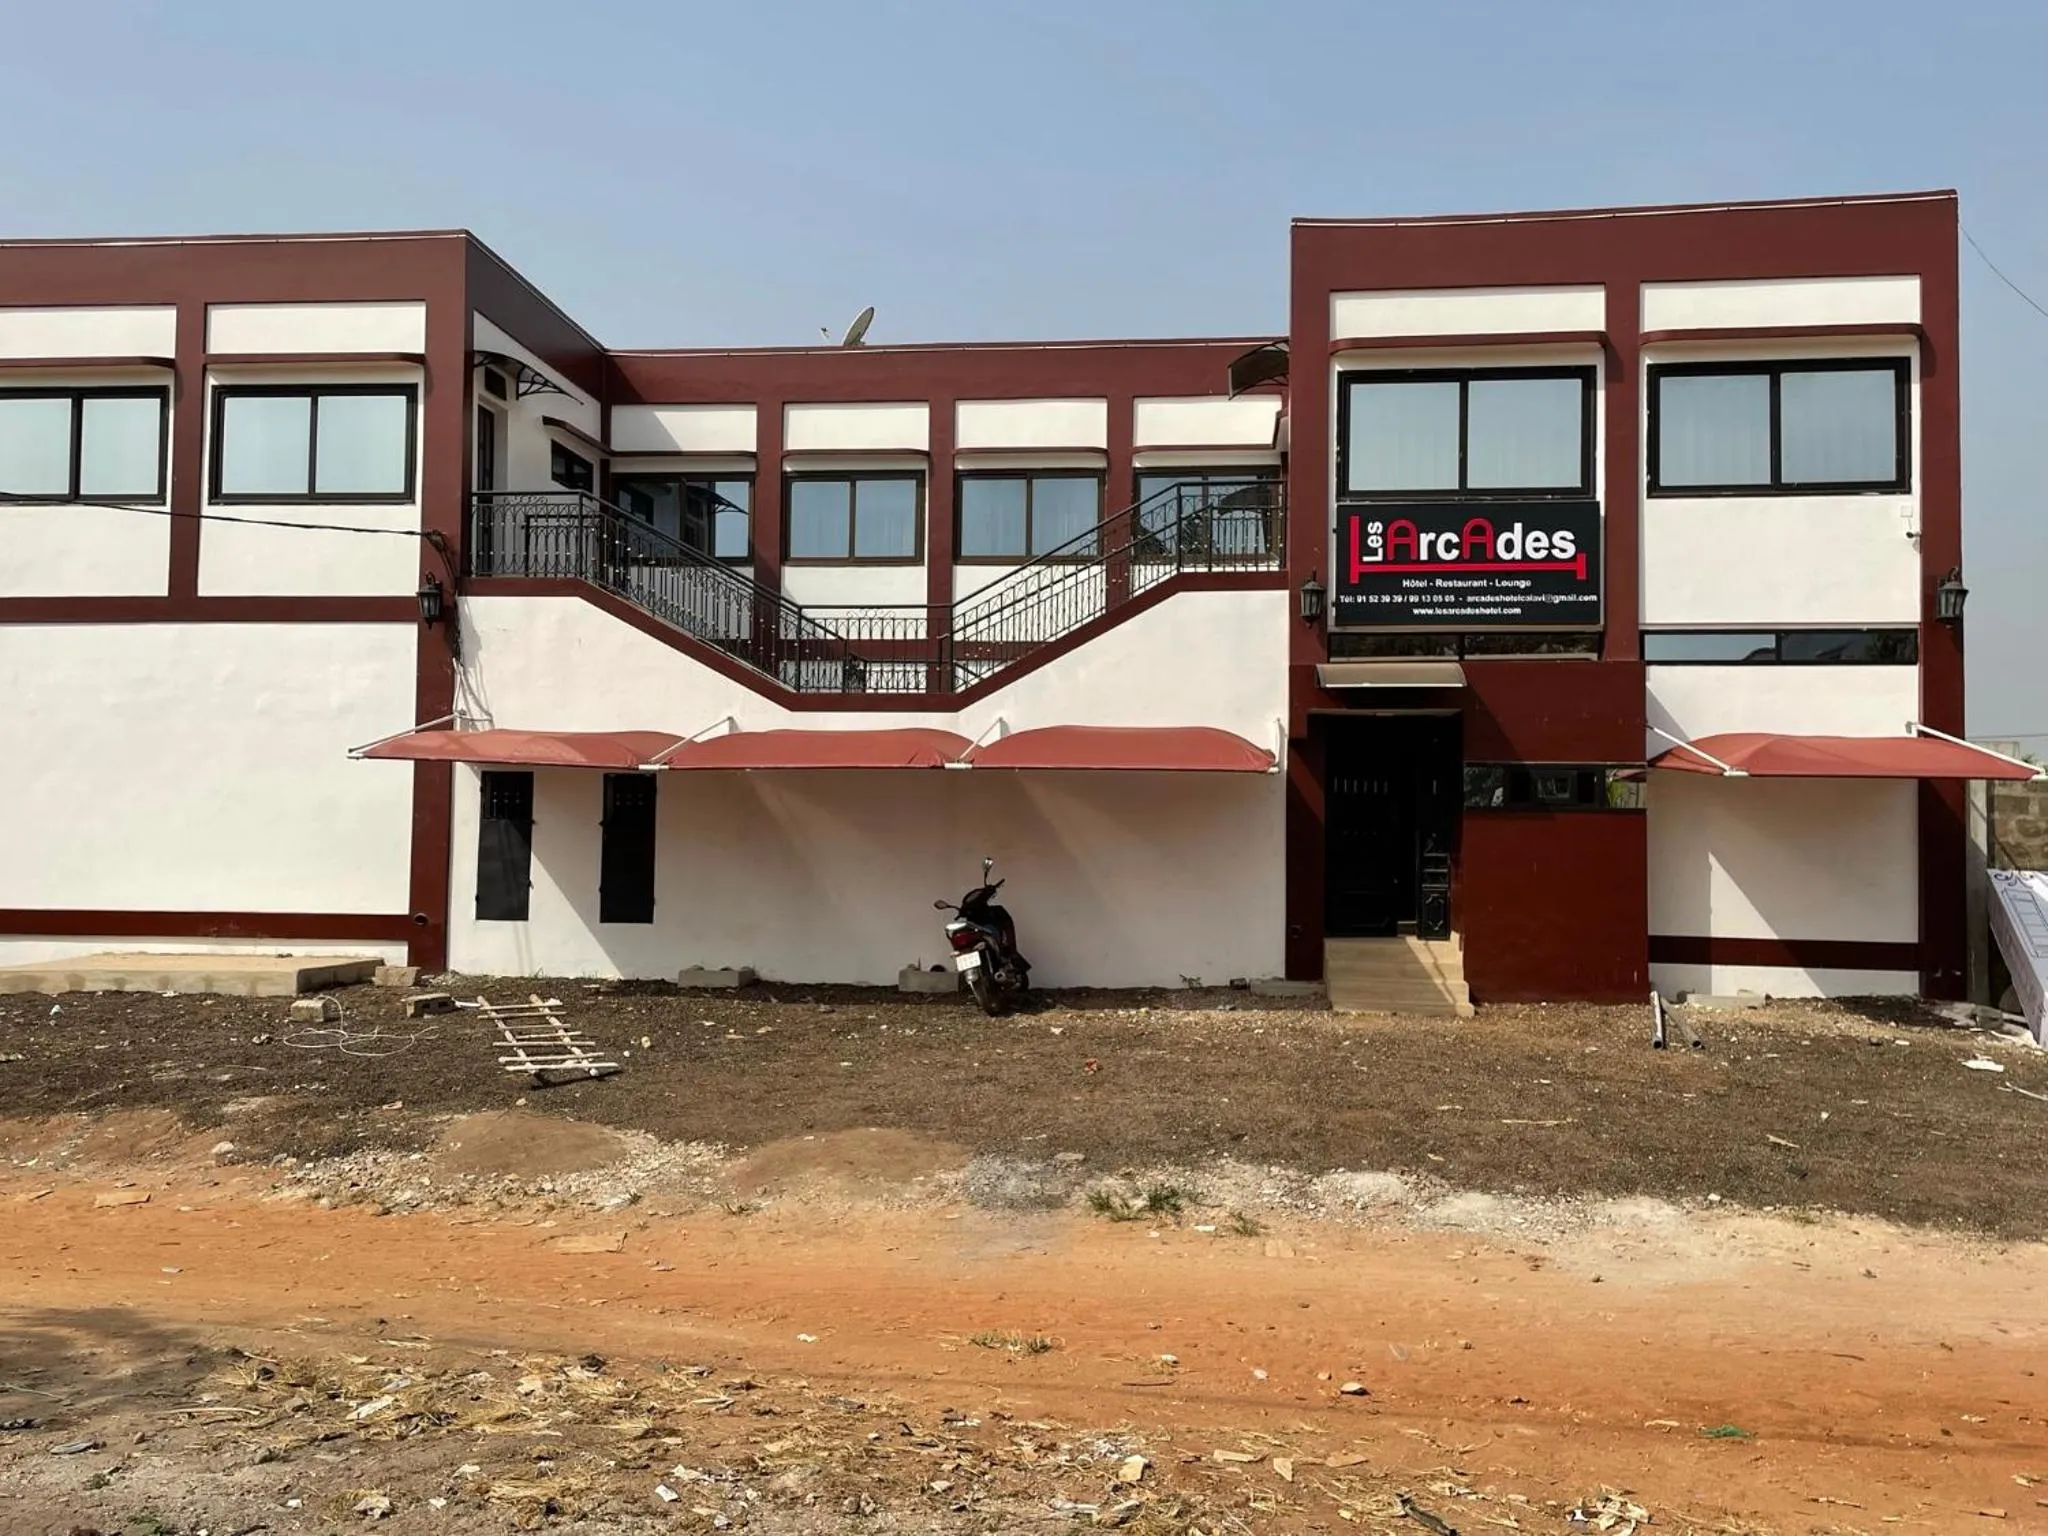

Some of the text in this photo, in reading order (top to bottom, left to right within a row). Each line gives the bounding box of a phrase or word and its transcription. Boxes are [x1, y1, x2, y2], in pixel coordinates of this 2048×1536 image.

[1363, 521, 1383, 562] Les
[1386, 518, 1576, 560] ArcAdes
[1402, 579, 1427, 588] Hôtel
[1435, 578, 1487, 588] Restaurant
[1495, 578, 1531, 589] Lounge
